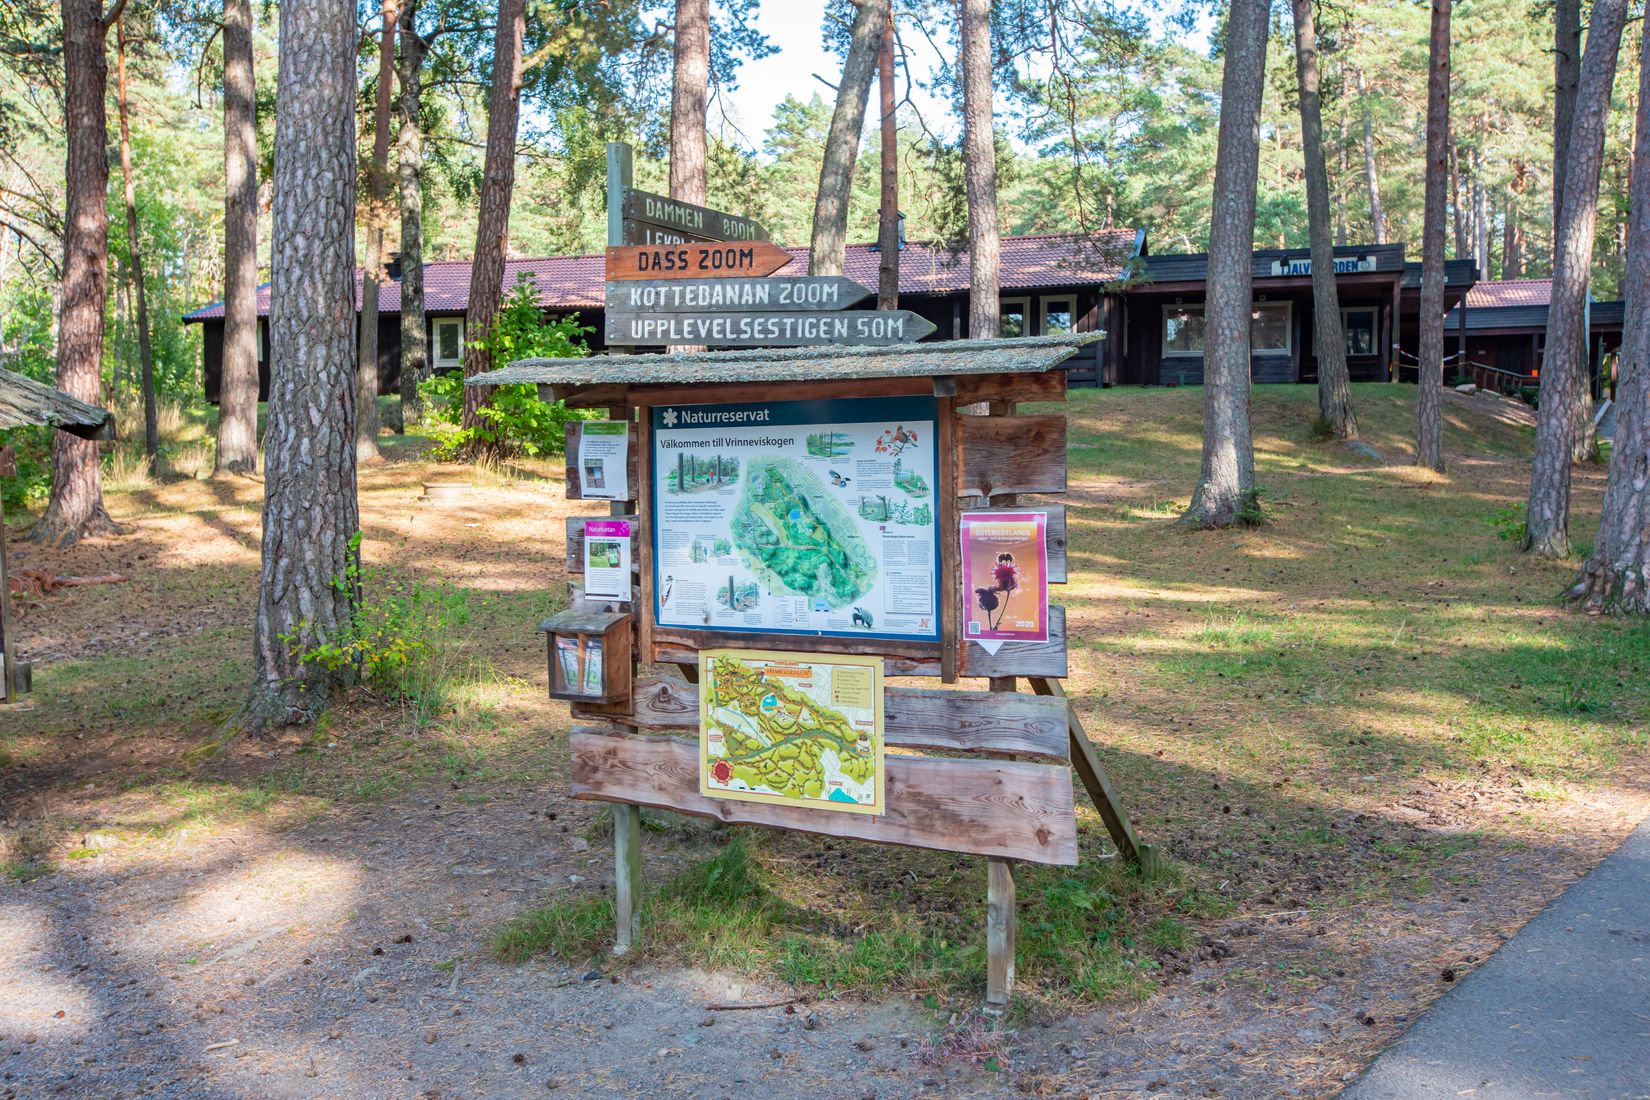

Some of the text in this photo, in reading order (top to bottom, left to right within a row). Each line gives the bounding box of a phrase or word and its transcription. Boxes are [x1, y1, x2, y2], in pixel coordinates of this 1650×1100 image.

[646, 198, 755, 241] DAMMEN 800M
[638, 248, 754, 272] DASS 200M
[630, 283, 839, 306] KOTTEBANAN 200M
[631, 317, 904, 339] UPPLEVELSESTIGEN 50M
[681, 408, 770, 424] Naturreservat
[660, 436, 795, 449] Välkommen till Vrinneviskogen
[1015, 620, 1035, 629] 2020
